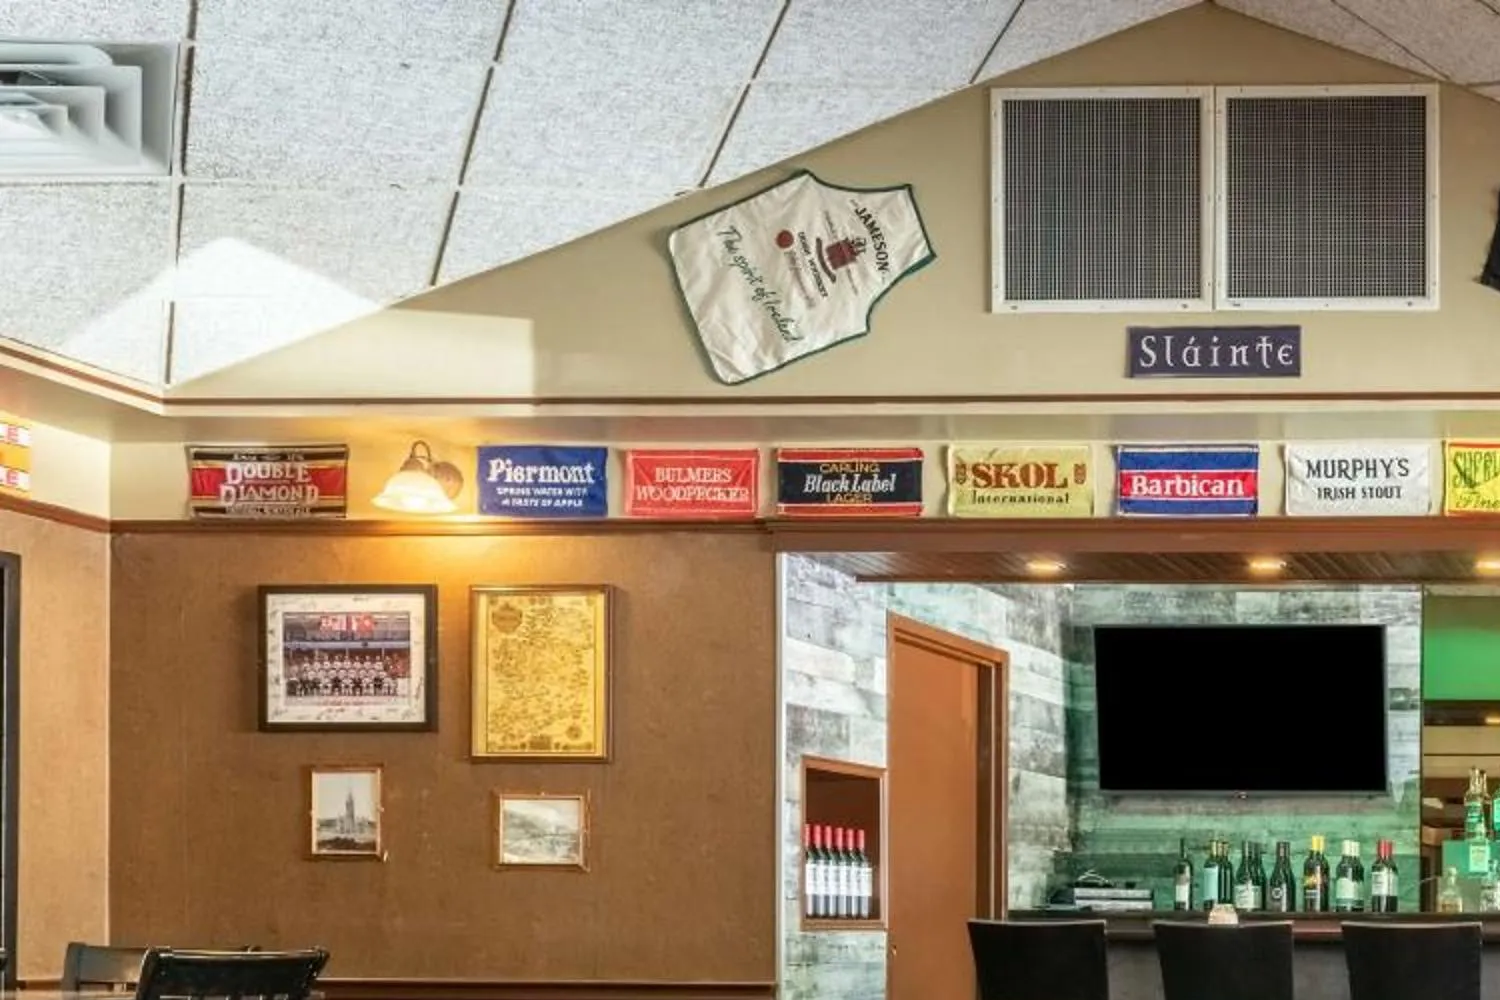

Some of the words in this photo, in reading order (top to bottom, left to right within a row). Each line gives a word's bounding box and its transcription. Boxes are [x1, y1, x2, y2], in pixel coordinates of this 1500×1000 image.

[854, 207, 890, 272] JAMESON
[1139, 335, 1294, 369] Sláinte
[225, 461, 313, 485] DOUBLE
[487, 457, 596, 484] Piermont
[655, 467, 732, 483] BULMERS
[819, 463, 881, 473] CARLING
[971, 462, 1069, 488] SKOL
[1306, 457, 1410, 480] MURPHY'S
[636, 485, 750, 501] WOODPECKER
[803, 473, 850, 493] Black
[851, 473, 897, 492] Label
[1130, 474, 1245, 496] Barbican
[1316, 487, 1356, 500] IRISH
[1361, 486, 1401, 499] STOUT
[219, 483, 320, 506] DIAMOND
[827, 493, 873, 504] LAGER
[972, 490, 1070, 504] International
